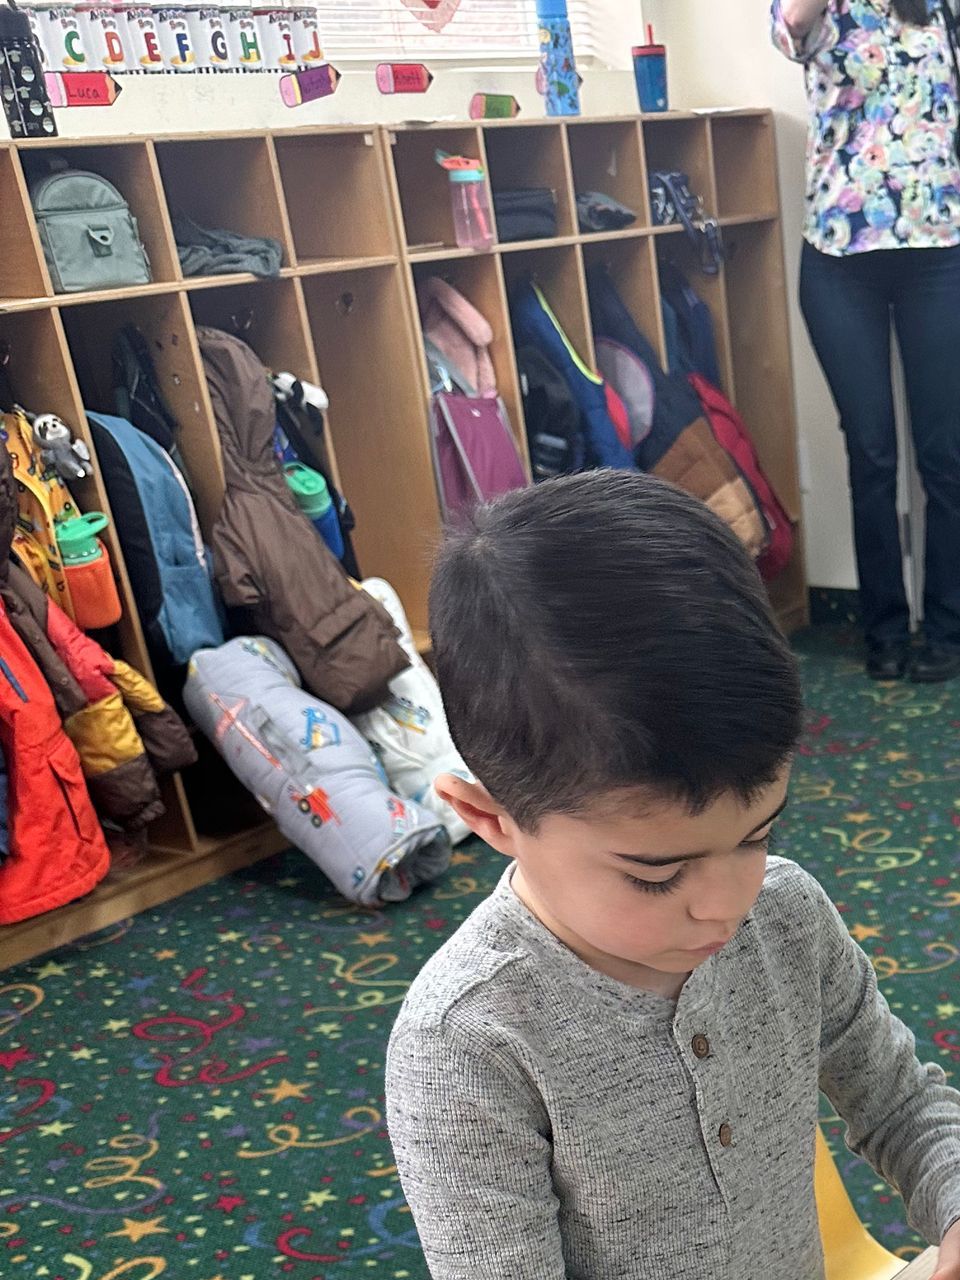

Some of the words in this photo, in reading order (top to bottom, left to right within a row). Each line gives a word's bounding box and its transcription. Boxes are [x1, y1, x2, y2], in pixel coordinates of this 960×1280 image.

[65, 31, 85, 62] C
[105, 32, 124, 62] D
[144, 32, 161, 62] E
[175, 33, 190, 62] F
[211, 31, 228, 60] G
[240, 32, 261, 60] H
[283, 34, 295, 60] I
[308, 31, 320, 58] J
